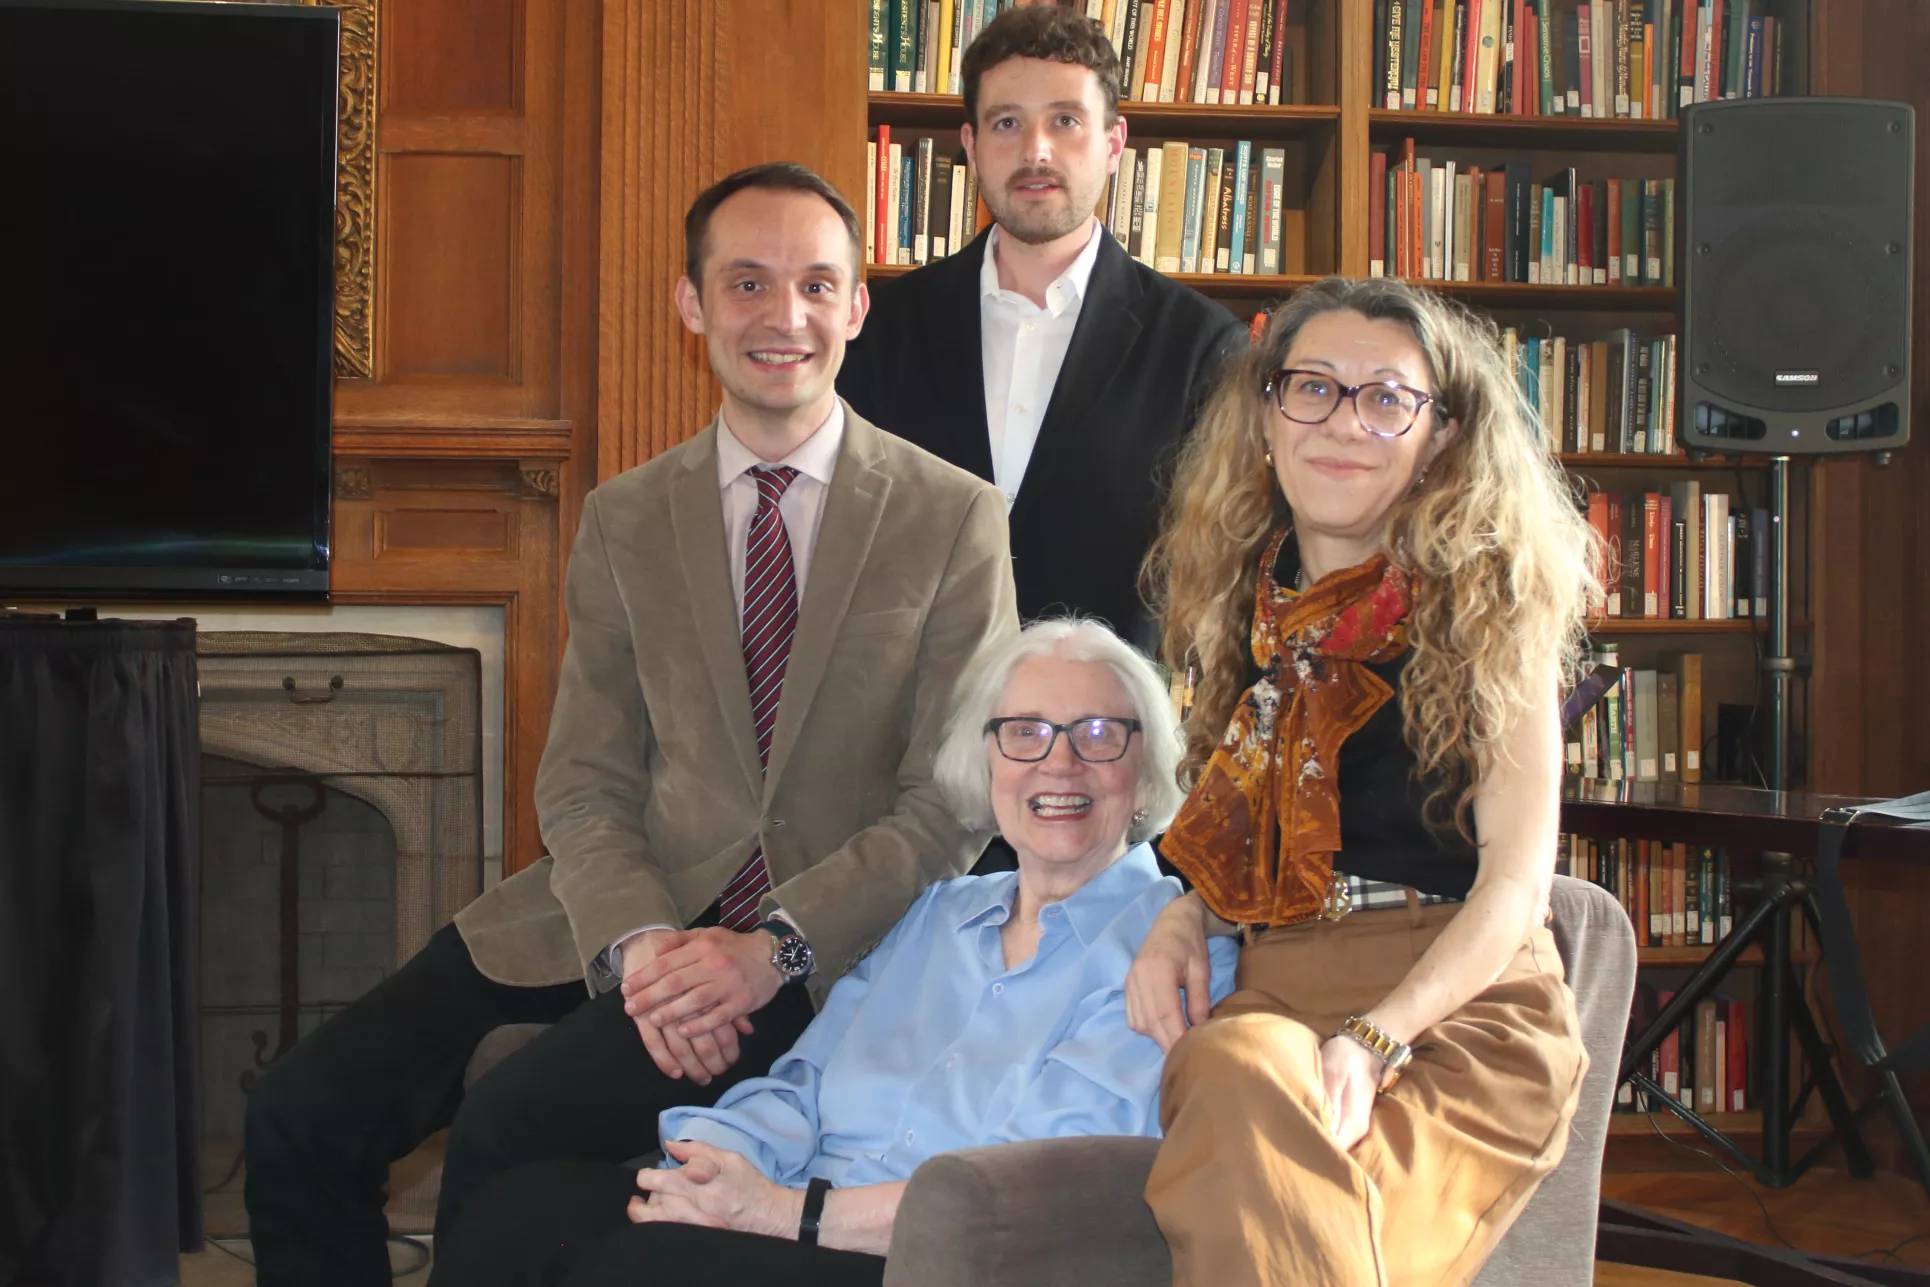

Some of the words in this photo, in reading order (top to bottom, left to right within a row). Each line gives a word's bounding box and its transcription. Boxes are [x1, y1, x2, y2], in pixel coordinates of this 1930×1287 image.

[1217, 9, 1225, 29] GOOD
[1391, 6, 1402, 25] GIVE
[1128, 30, 1136, 50] WORLD
[1390, 26, 1401, 40] ME
[1542, 22, 1550, 53] Sensitive
[1245, 52, 1255, 73] SUMMER
[1543, 55, 1551, 78] Chaos
[1228, 64, 1237, 86] WEST
[1167, 149, 1179, 233] MOUNTAINS
[1273, 184, 1282, 199] EDGE
[1221, 186, 1232, 230] Albatross
[1272, 208, 1281, 219] THE
[1273, 200, 1281, 208] OF
[1271, 220, 1280, 241] WORLD
[1633, 540, 1641, 578] MARLENE
[1610, 703, 1618, 734] EARTH
